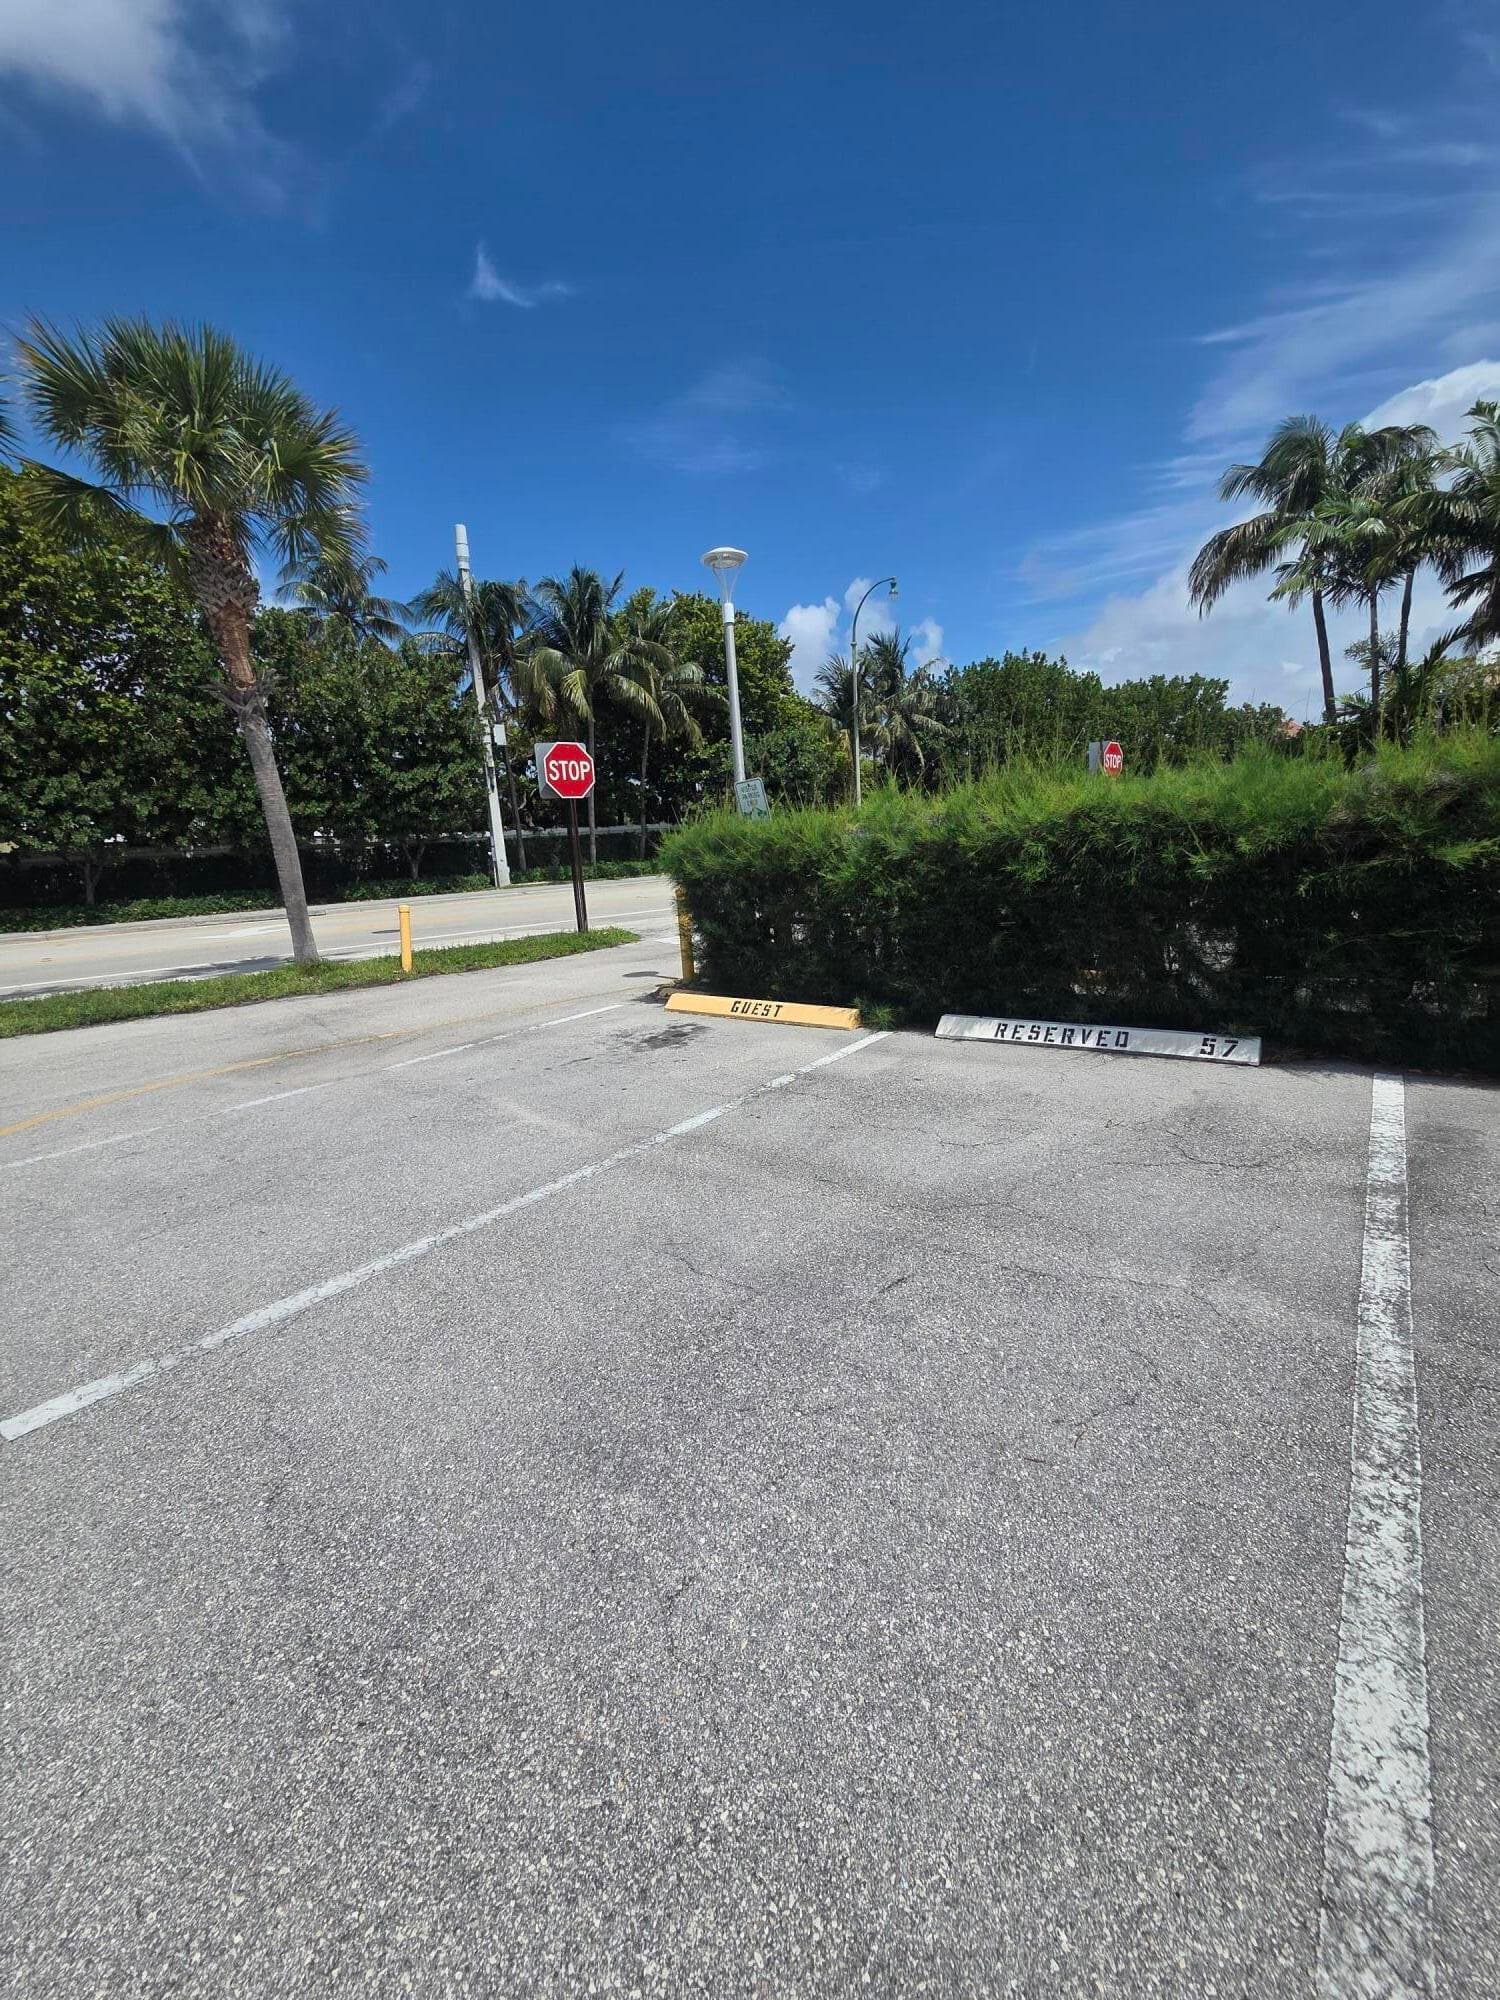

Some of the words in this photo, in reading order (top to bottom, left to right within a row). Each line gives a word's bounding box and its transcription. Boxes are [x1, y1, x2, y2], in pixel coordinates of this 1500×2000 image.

[548, 760, 590, 780] STOP
[1105, 753, 1121, 769] STOP
[730, 1000, 783, 1017] GUEST
[994, 1022, 1130, 1048] RESERVED
[1200, 1037, 1239, 1057] 57
